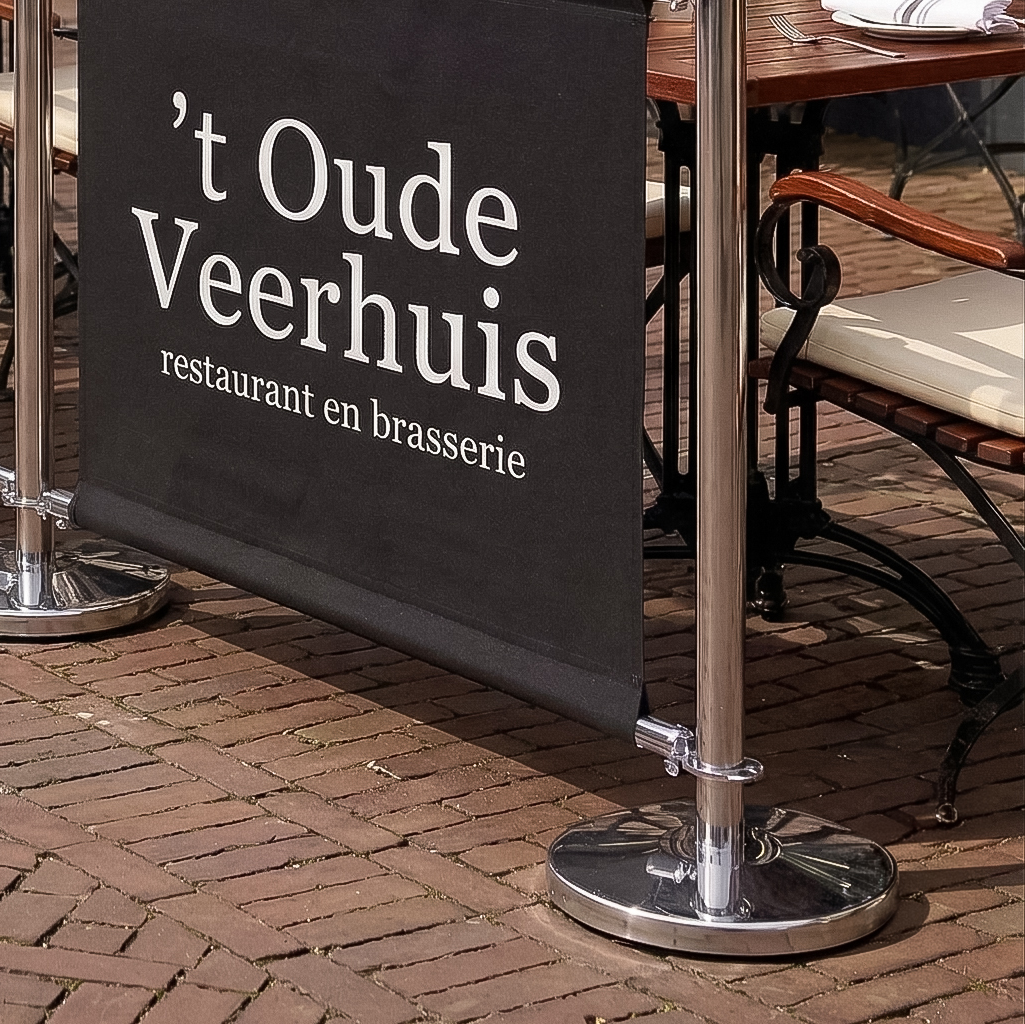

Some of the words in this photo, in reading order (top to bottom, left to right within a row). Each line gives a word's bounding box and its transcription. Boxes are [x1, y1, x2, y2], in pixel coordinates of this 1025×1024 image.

[173, 92, 226, 201] ’t
[259, 119, 518, 266] Oude
[132, 207, 560, 411] Veerhuis
[161, 350, 314, 417] restaurant
[324, 399, 361, 432] en
[370, 398, 525, 478] brasserie
